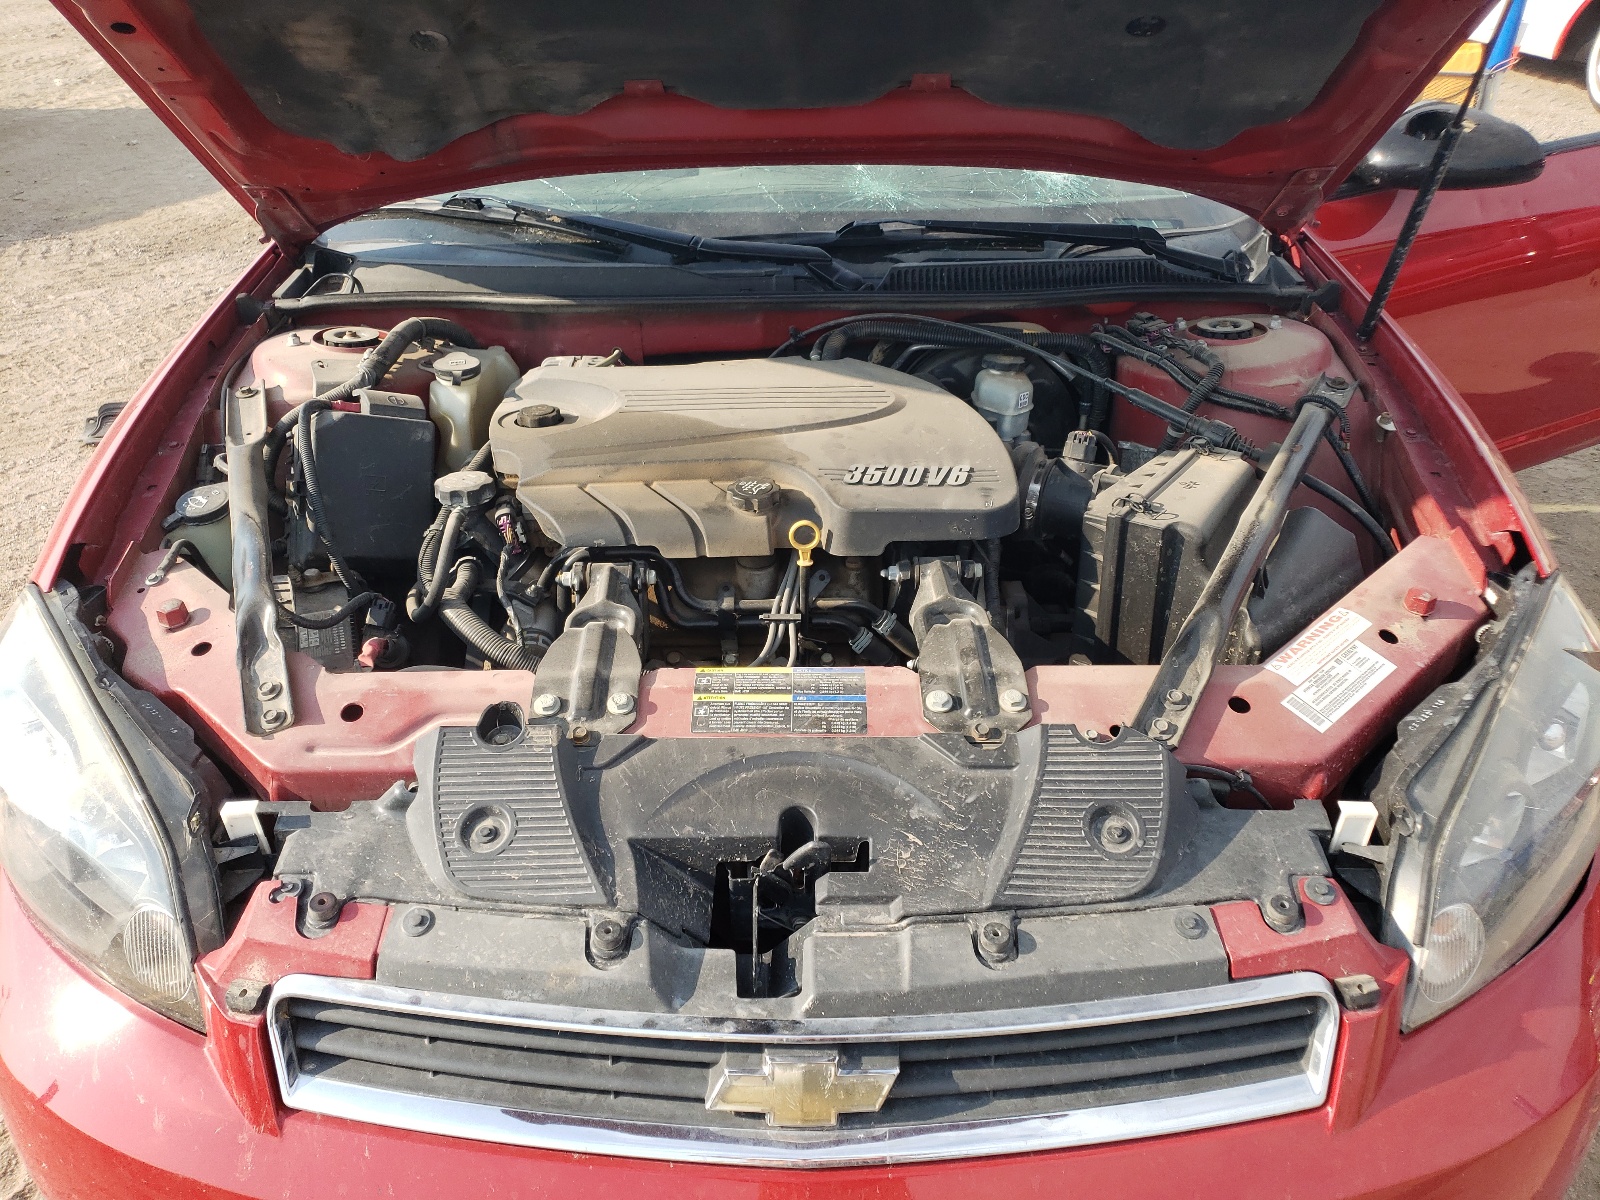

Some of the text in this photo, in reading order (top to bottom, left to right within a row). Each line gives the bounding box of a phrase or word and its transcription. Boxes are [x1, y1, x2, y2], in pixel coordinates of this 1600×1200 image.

[842, 463, 974, 487] 3500 V6
[1275, 613, 1343, 664] WARNING
